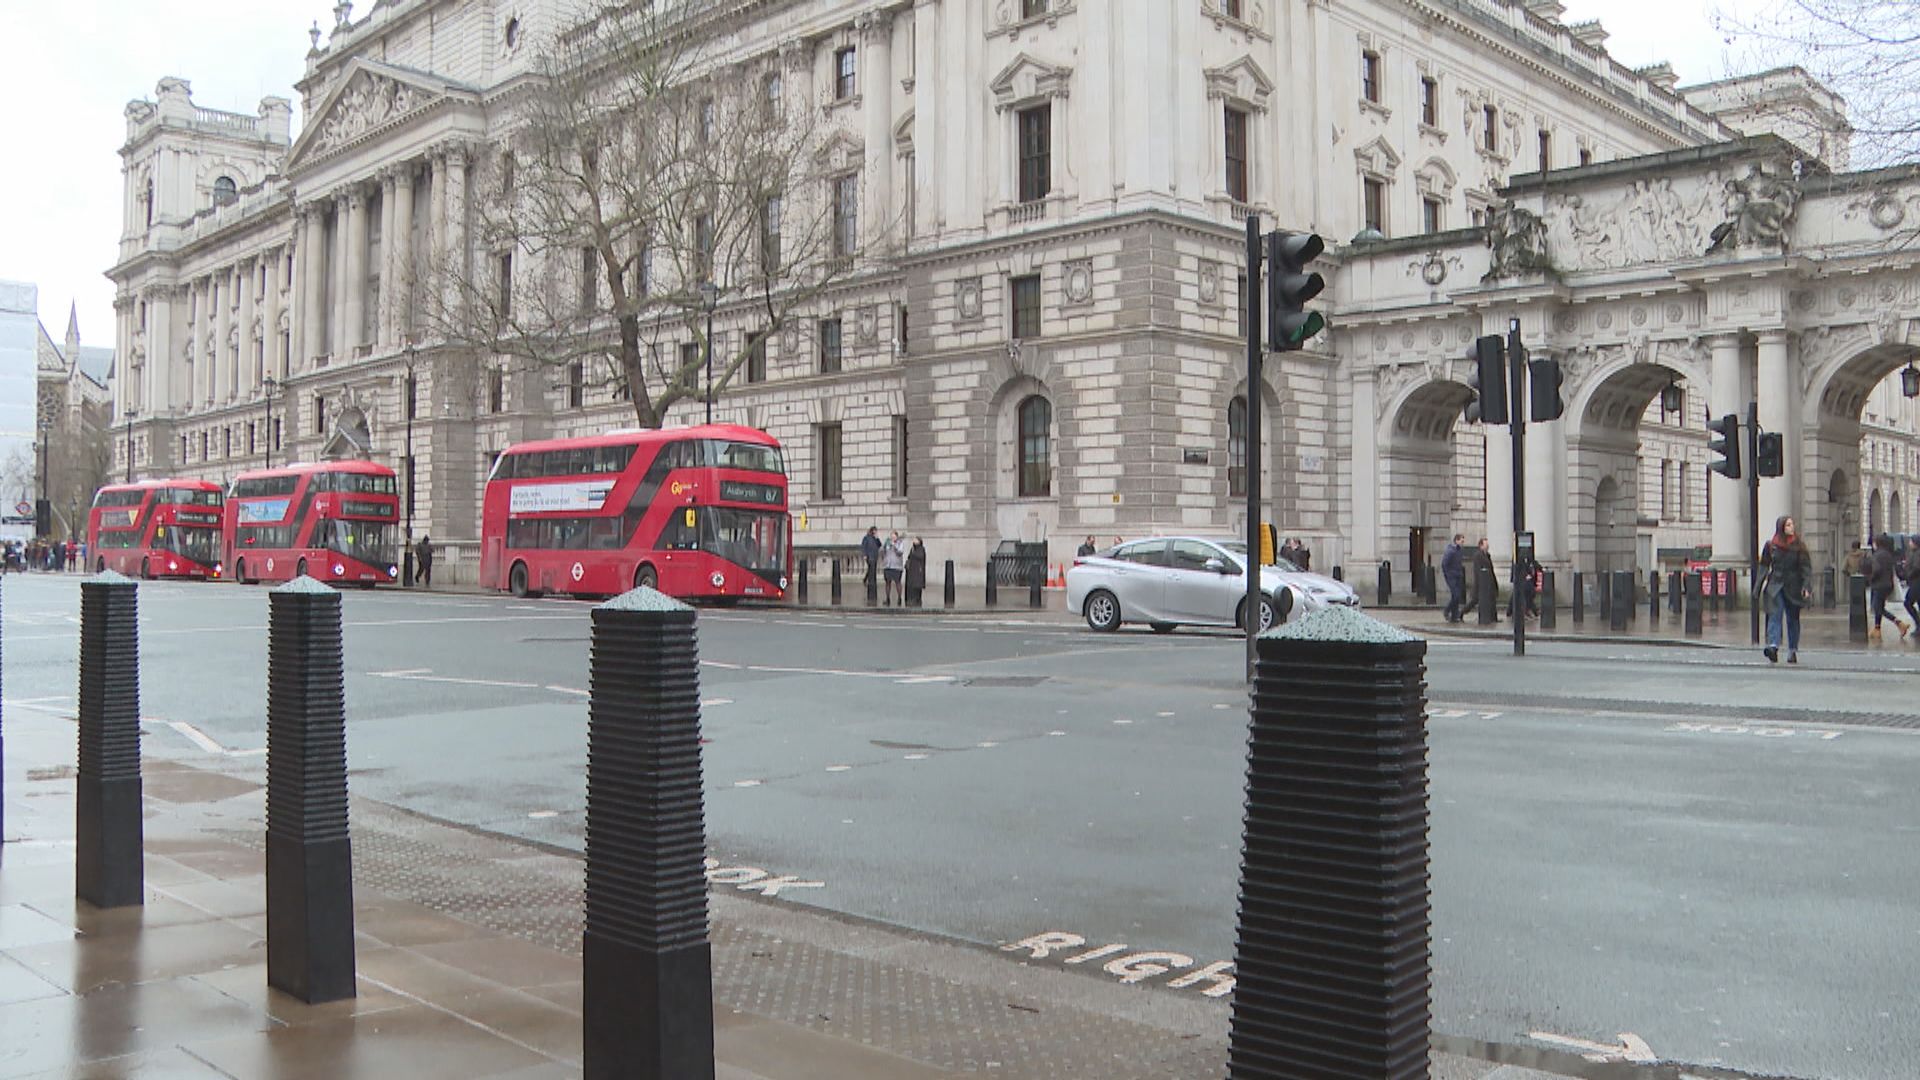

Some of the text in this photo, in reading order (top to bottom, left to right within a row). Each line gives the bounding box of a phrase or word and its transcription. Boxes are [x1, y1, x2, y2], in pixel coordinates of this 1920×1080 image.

[765, 488, 778, 502] 87
[703, 858, 825, 895] OK
[999, 931, 1237, 997] RIGH
